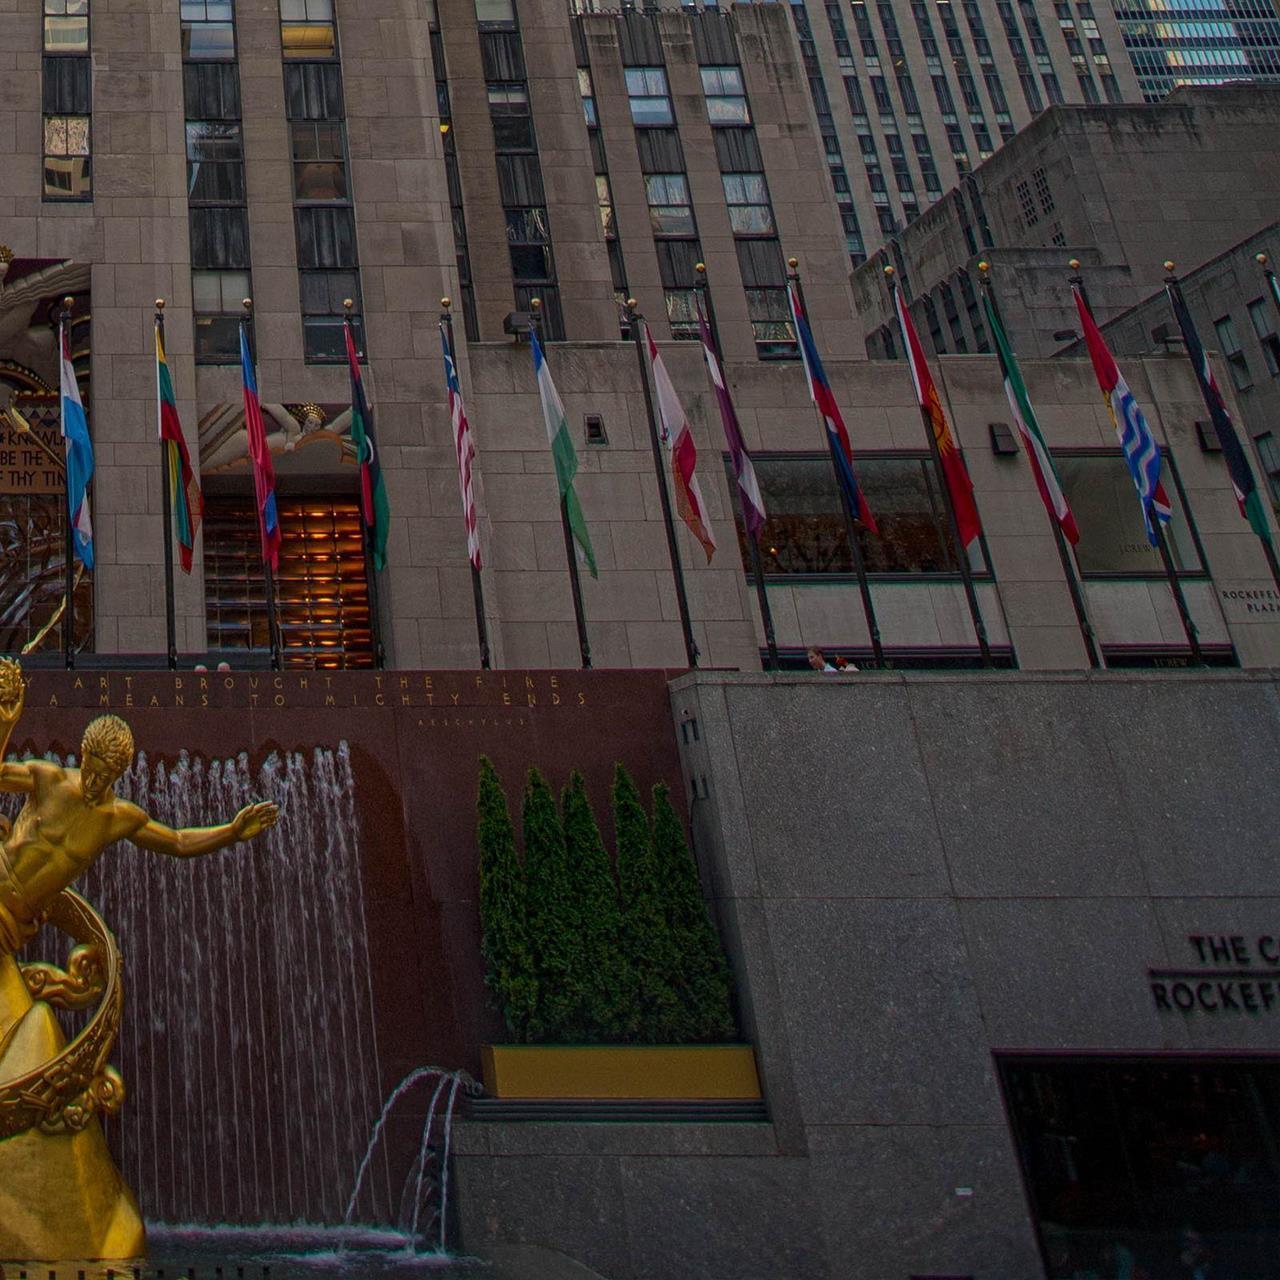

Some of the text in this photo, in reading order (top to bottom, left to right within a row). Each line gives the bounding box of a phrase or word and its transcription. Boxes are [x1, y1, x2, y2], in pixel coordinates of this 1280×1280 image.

[0, 450, 17, 466] BE
[21, 450, 43, 466] THE
[8, 470, 37, 487] THY
[73, 676, 134, 690] ART
[374, 676, 433, 689] THE
[475, 676, 559, 689] FIRE
[49, 693, 59, 707] A
[99, 692, 209, 707] MEANS
[249, 693, 285, 707] TO
[324, 693, 460, 706] MIGHTY
[503, 692, 585, 706] ENDS
[1189, 935, 1280, 963] THE C
[1151, 982, 1280, 1011] ROCKEF
